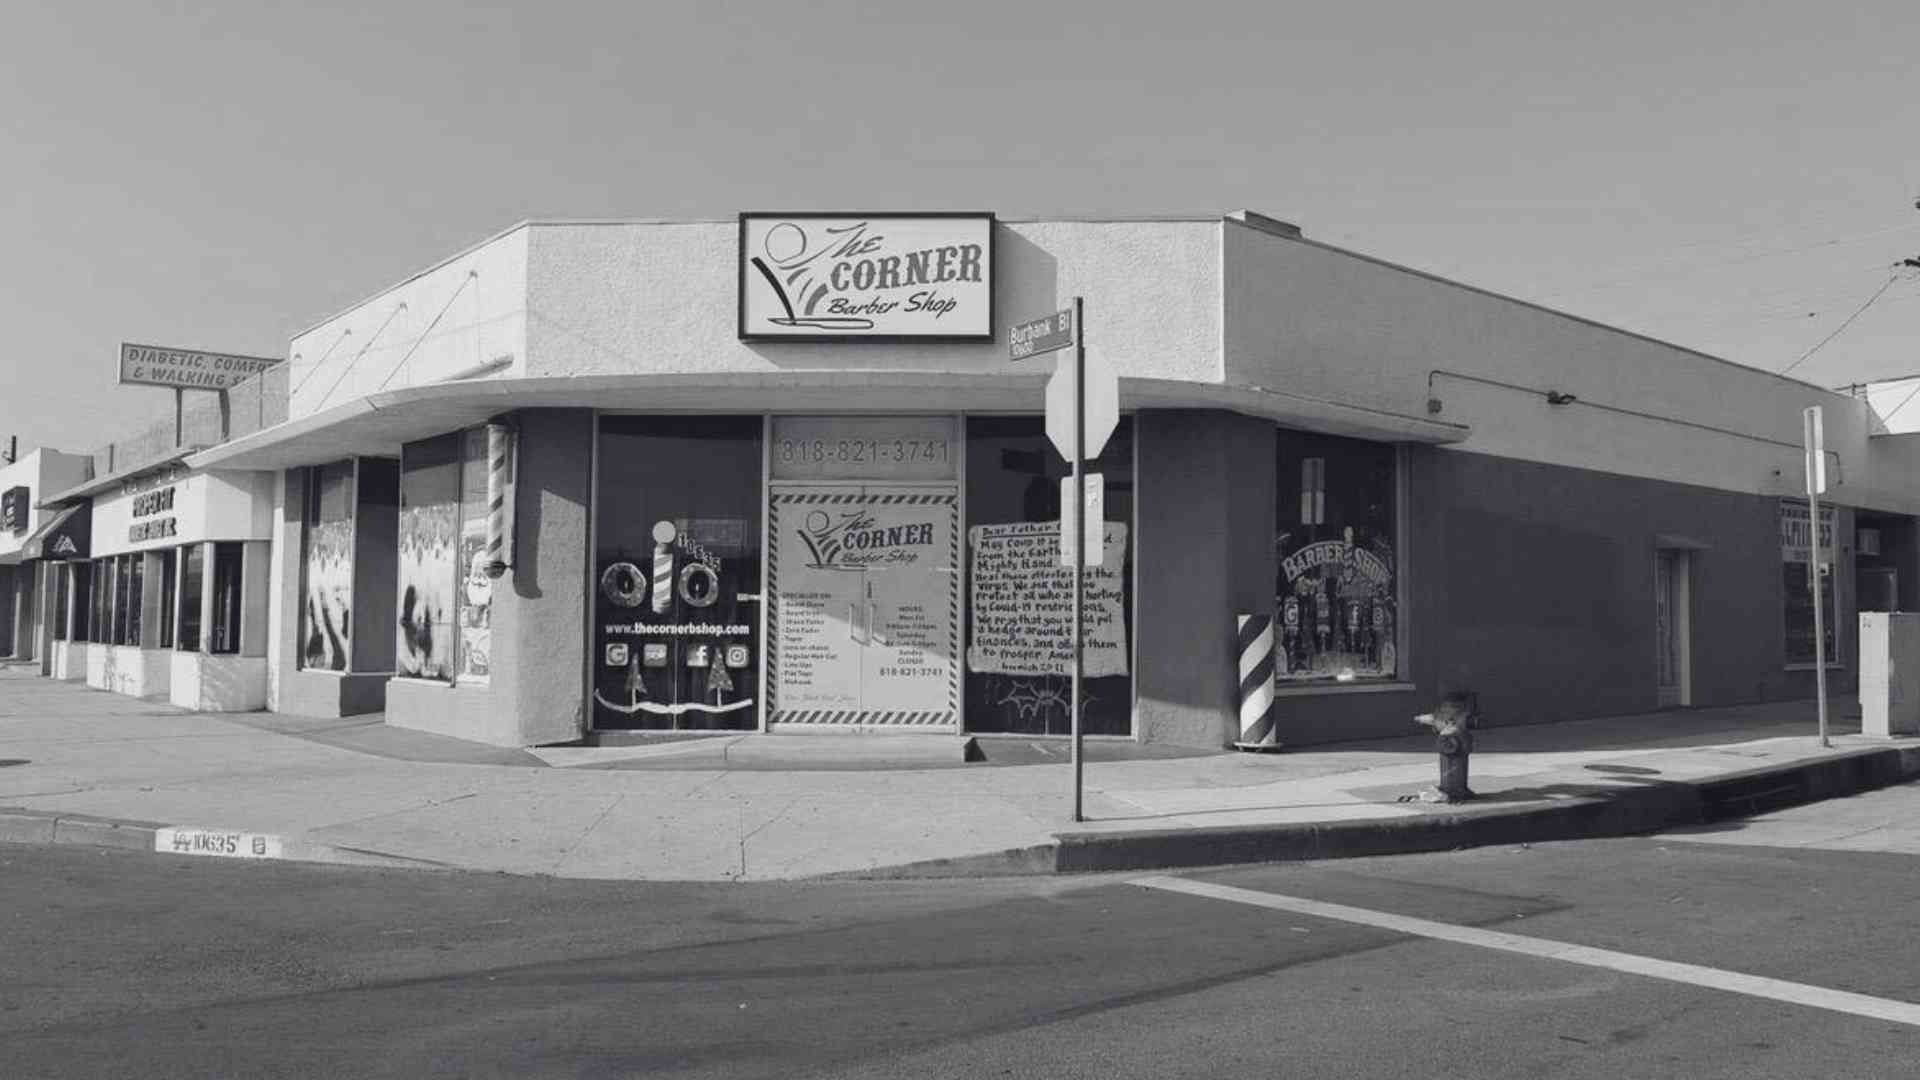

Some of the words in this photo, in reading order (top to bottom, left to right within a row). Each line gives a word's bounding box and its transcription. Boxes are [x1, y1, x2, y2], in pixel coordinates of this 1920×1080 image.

[817, 221, 885, 260] The
[829, 243, 983, 293] CORNER
[826, 294, 900, 316] Barber
[902, 290, 958, 320] Shop
[1010, 319, 1050, 345] Burbank
[1059, 312, 1070, 332] Bl
[133, 367, 144, 379] &
[151, 367, 225, 387] WALKING
[781, 438, 949, 462] 818-821-3741
[840, 510, 876, 532] The
[842, 522, 934, 551] CORNER
[884, 549, 920, 566] Shop
[1281, 543, 1345, 584] BARBER
[1087, 638, 1118, 649] them
[880, 668, 943, 677] 818-821-3741
